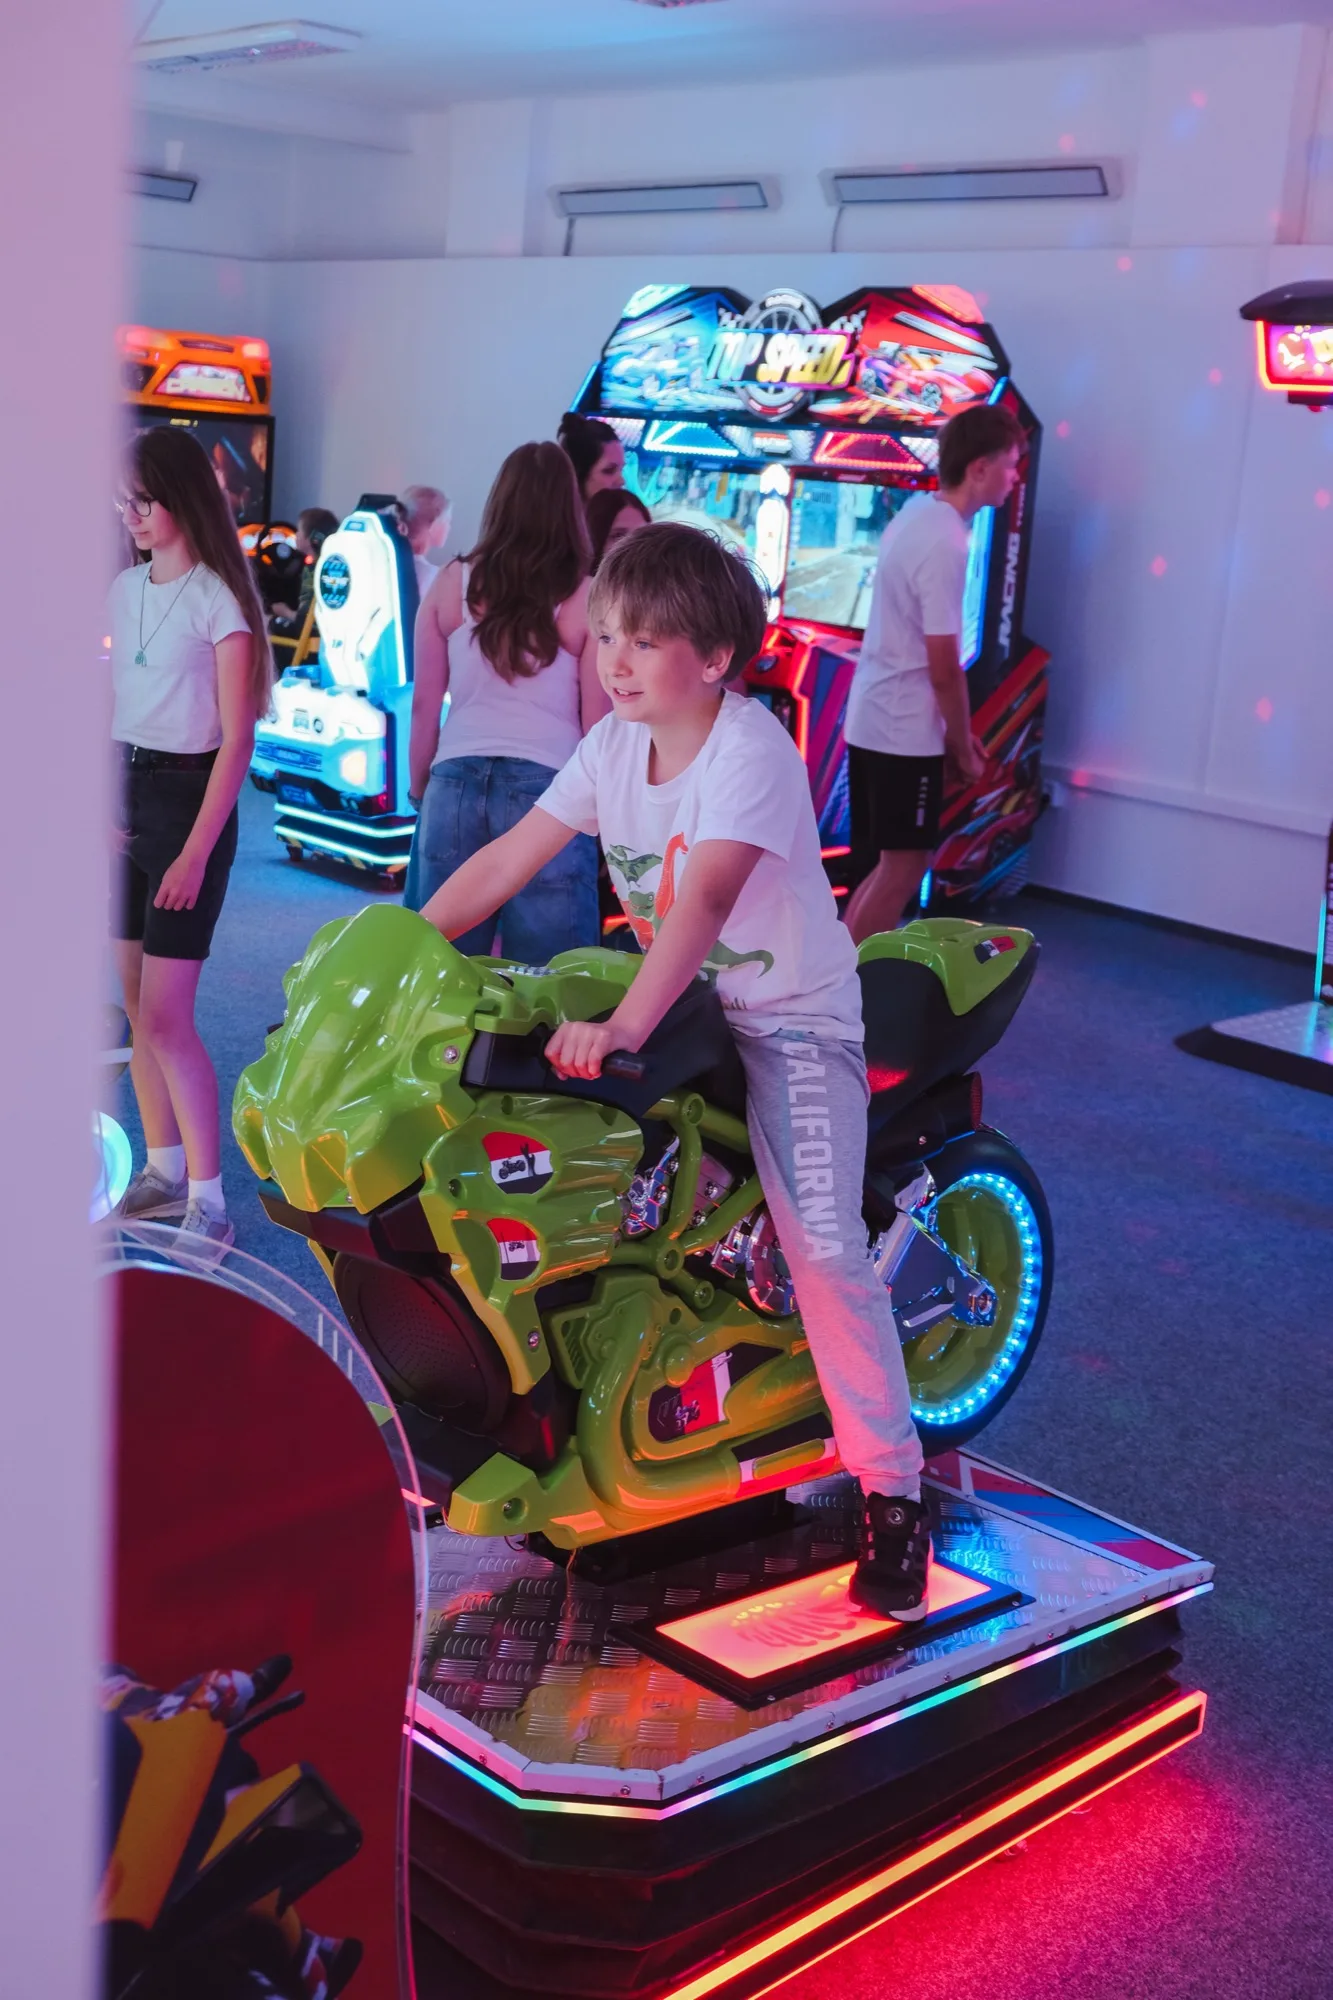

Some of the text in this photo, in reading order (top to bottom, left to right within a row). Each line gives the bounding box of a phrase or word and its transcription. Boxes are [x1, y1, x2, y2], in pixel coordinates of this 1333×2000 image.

[756, 332, 848, 385] SPEED
[998, 531, 1021, 650] RACING
[782, 1041, 844, 1262] CALIFORNIA
